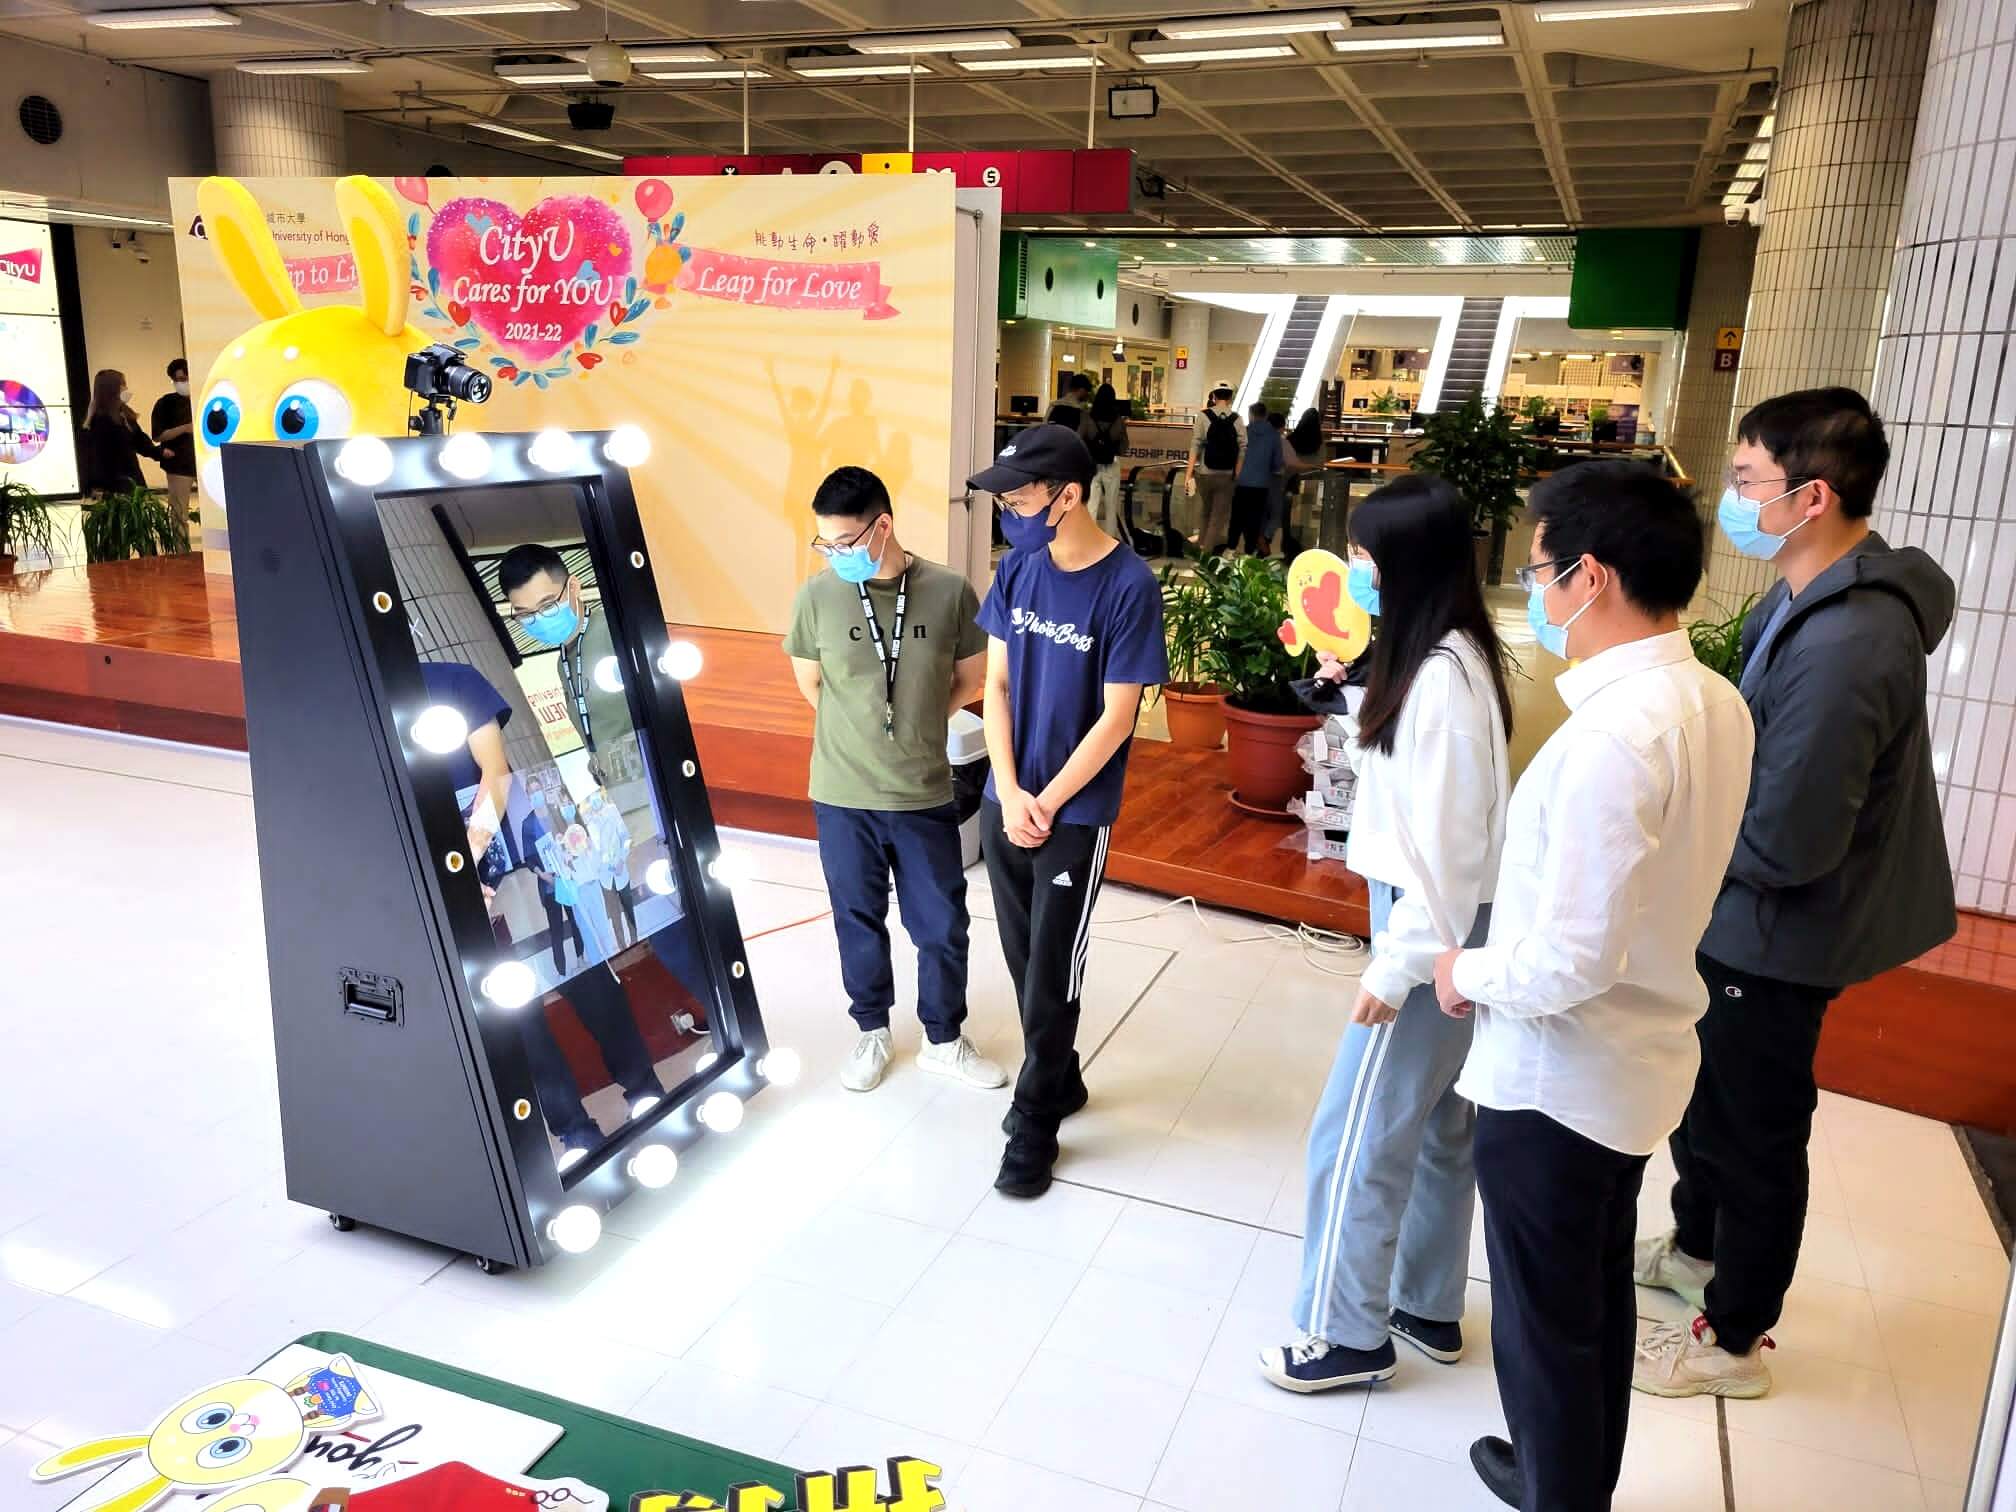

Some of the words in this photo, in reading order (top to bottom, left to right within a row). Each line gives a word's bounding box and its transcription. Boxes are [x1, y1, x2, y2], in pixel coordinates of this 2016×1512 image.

[314, 230, 323, 242] of
[480, 219, 575, 274] CityU
[310, 263, 328, 284] to
[453, 276, 512, 305] Cares
[510, 274, 551, 312] for
[554, 275, 613, 305] YOU
[696, 266, 755, 303] Leap
[754, 266, 798, 304] for
[801, 271, 862, 299] Love
[504, 322, 563, 341] 2021-22
[1720, 352, 1732, 368] B
[1124, 448, 1163, 459] ERSHIP
